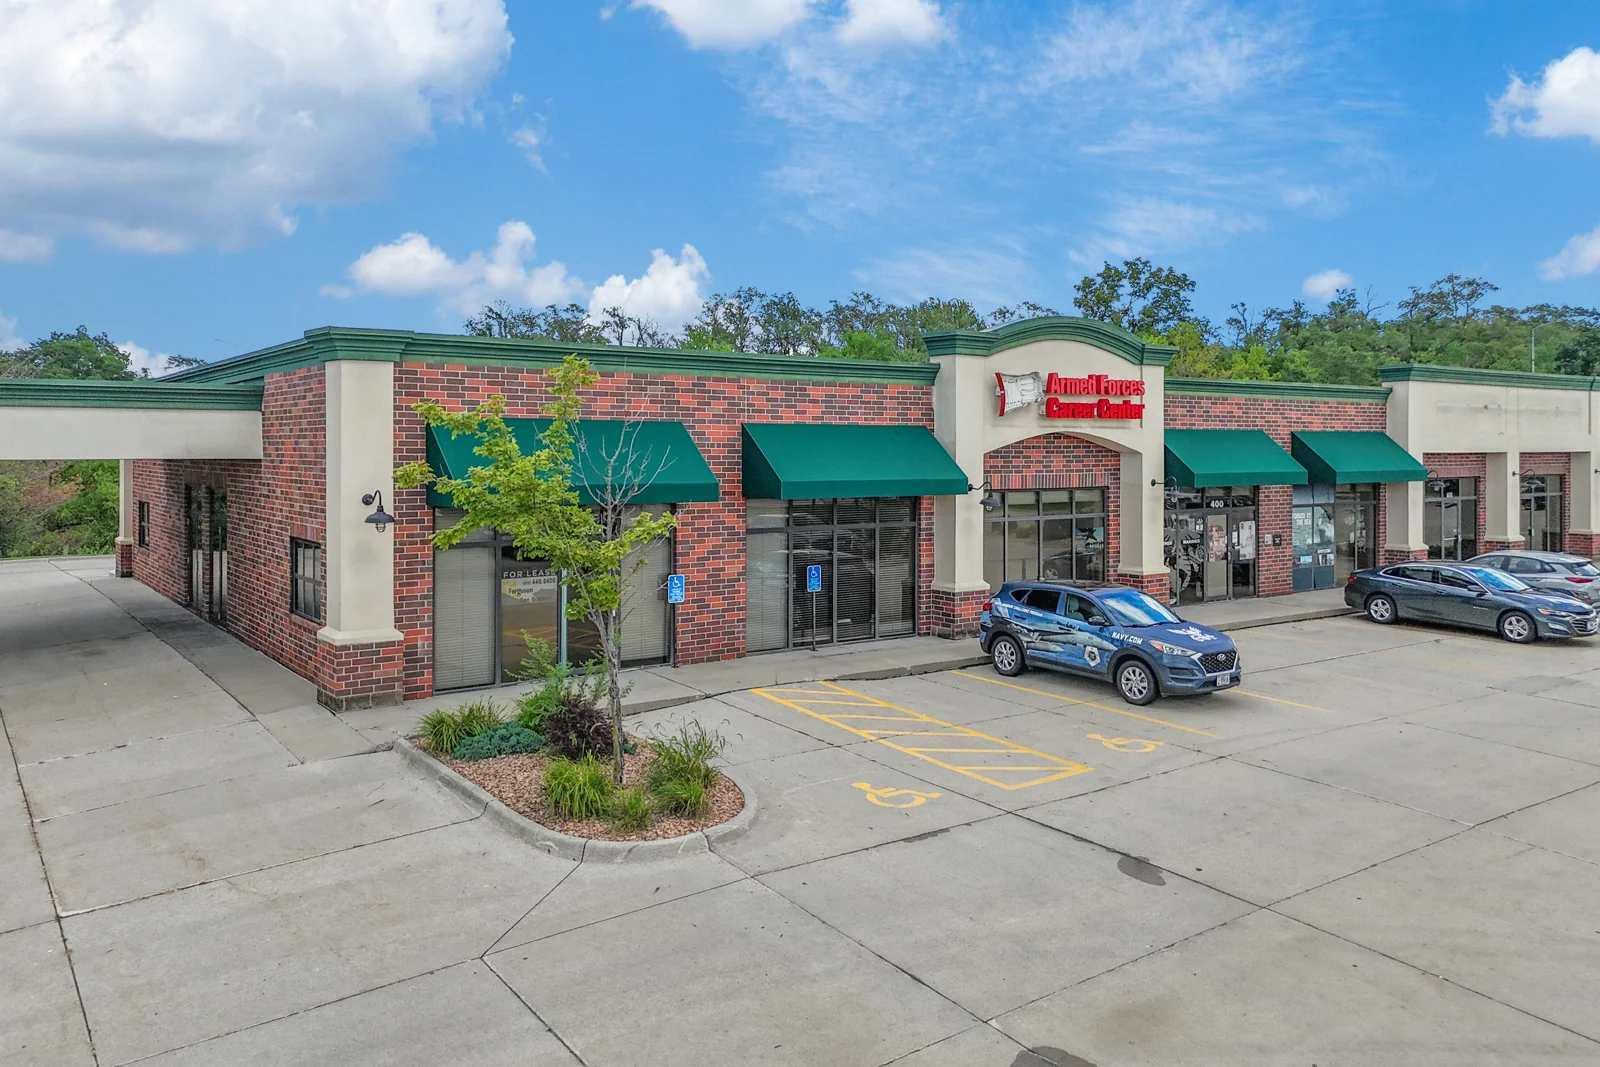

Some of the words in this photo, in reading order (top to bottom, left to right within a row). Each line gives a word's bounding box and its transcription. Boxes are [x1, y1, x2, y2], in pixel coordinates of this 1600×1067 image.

[1046, 373, 1096, 395] Armed
[1097, 374, 1145, 396] Forces
[1046, 397, 1097, 418] Career
[1097, 398, 1145, 419] Center
[1210, 500, 1224, 508] 400
[503, 571, 523, 579] FOR
[508, 588, 534, 597] Ferguson
[1111, 631, 1143, 645] NAVY.COM
